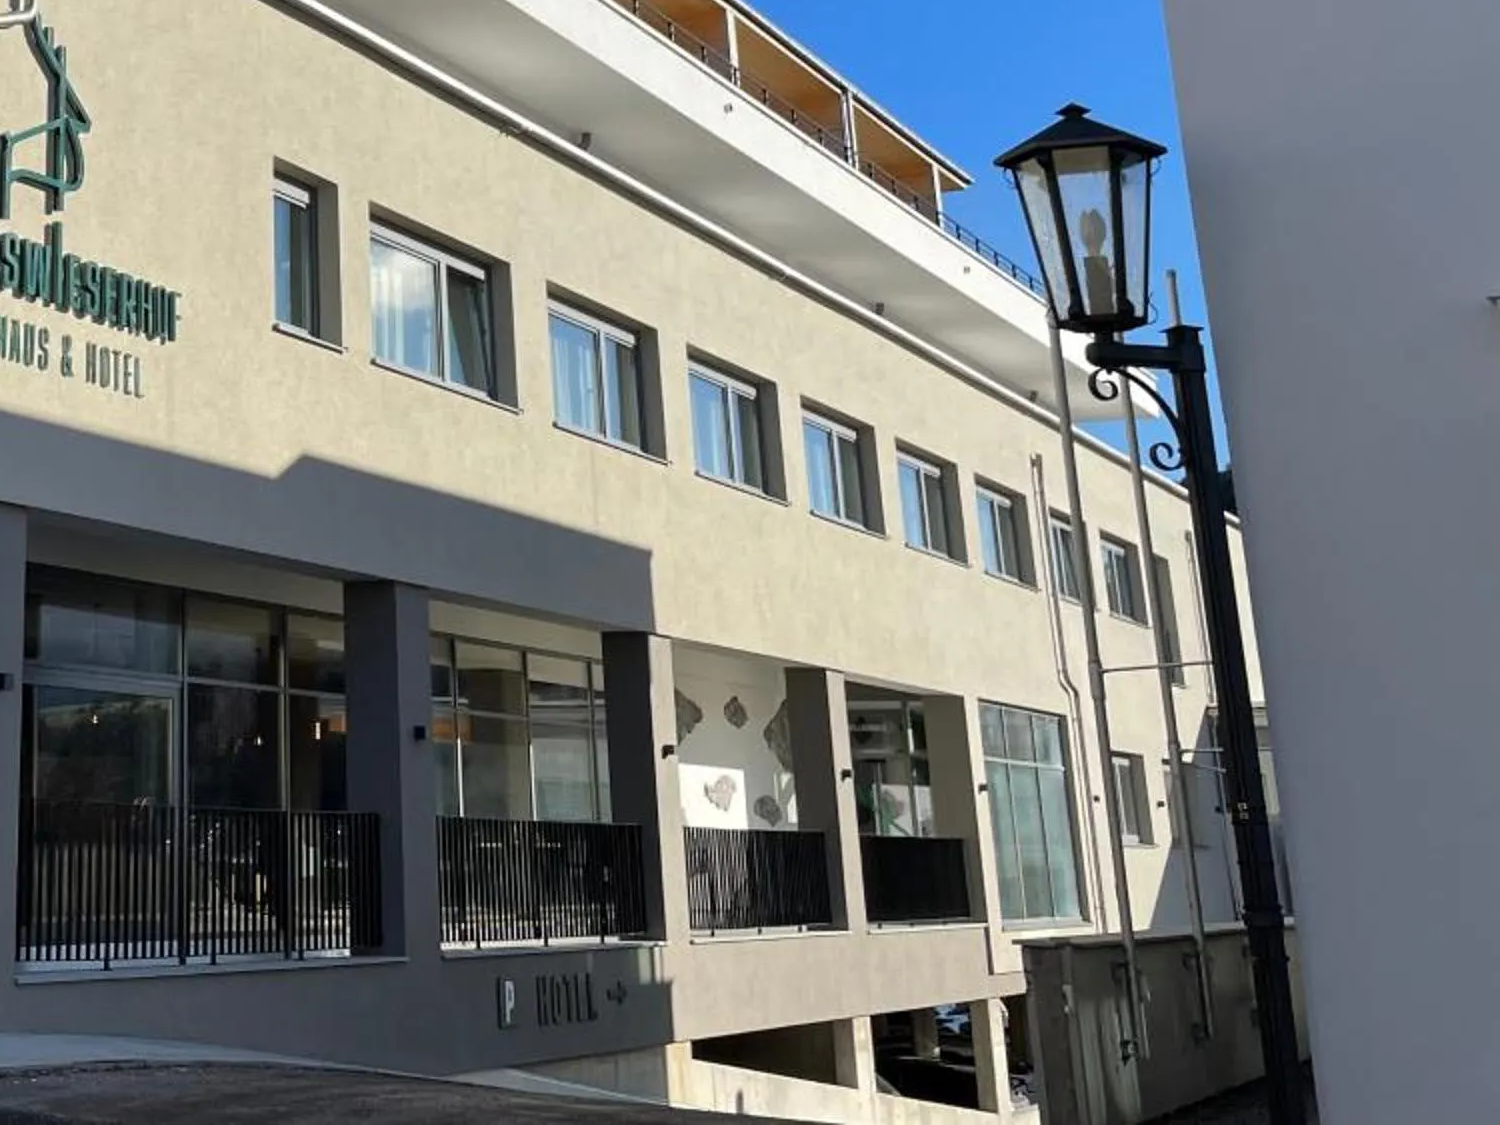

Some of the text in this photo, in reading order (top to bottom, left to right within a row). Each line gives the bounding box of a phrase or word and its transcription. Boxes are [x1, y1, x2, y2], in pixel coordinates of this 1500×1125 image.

[60, 334, 74, 378] &
[85, 342, 145, 399] HOTEL
[534, 973, 599, 1028] HOTEL
